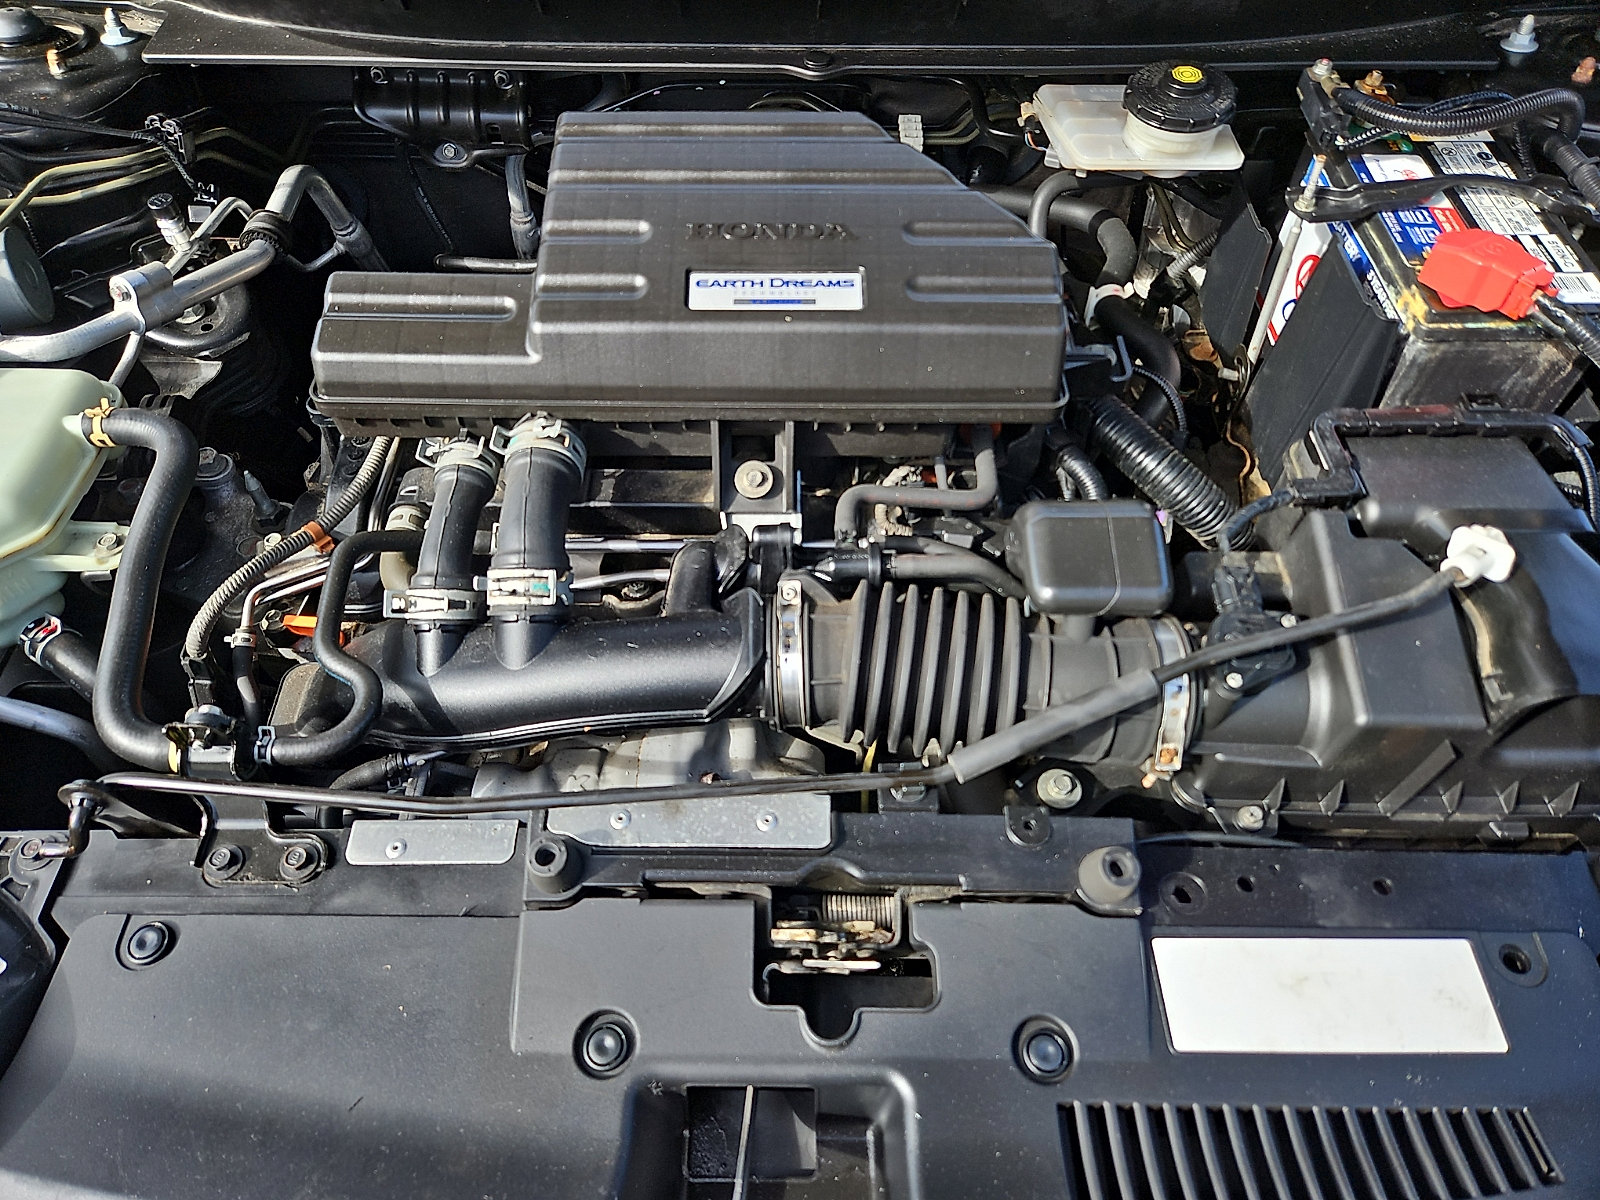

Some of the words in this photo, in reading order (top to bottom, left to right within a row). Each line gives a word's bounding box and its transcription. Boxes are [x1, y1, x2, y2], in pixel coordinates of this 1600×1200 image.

[685, 222, 858, 240] HONDA
[695, 278, 764, 288] EARTH
[770, 277, 855, 288] DREAMS
